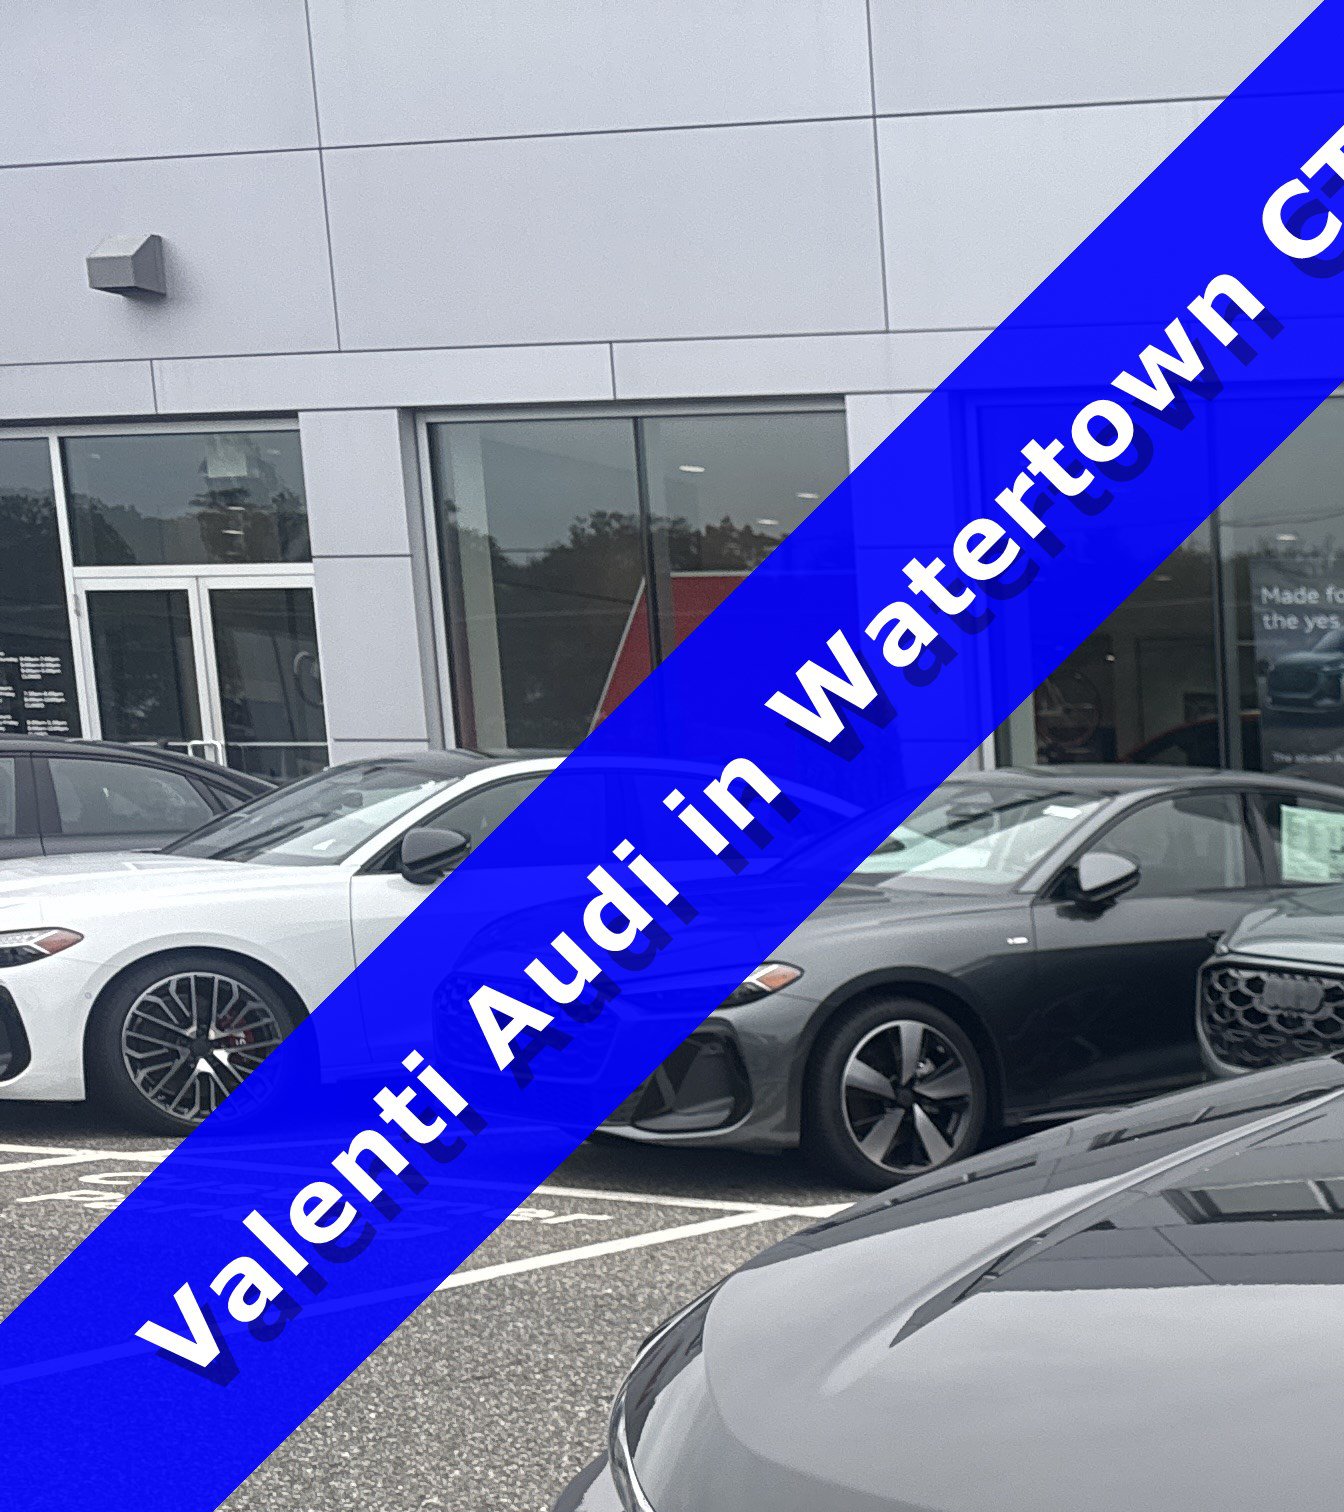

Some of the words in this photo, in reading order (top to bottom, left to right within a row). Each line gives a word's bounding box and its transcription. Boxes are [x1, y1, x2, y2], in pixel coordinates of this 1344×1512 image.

[1261, 586, 1320, 604] Made
[1263, 611, 1300, 630] the
[1303, 613, 1340, 633] yes
